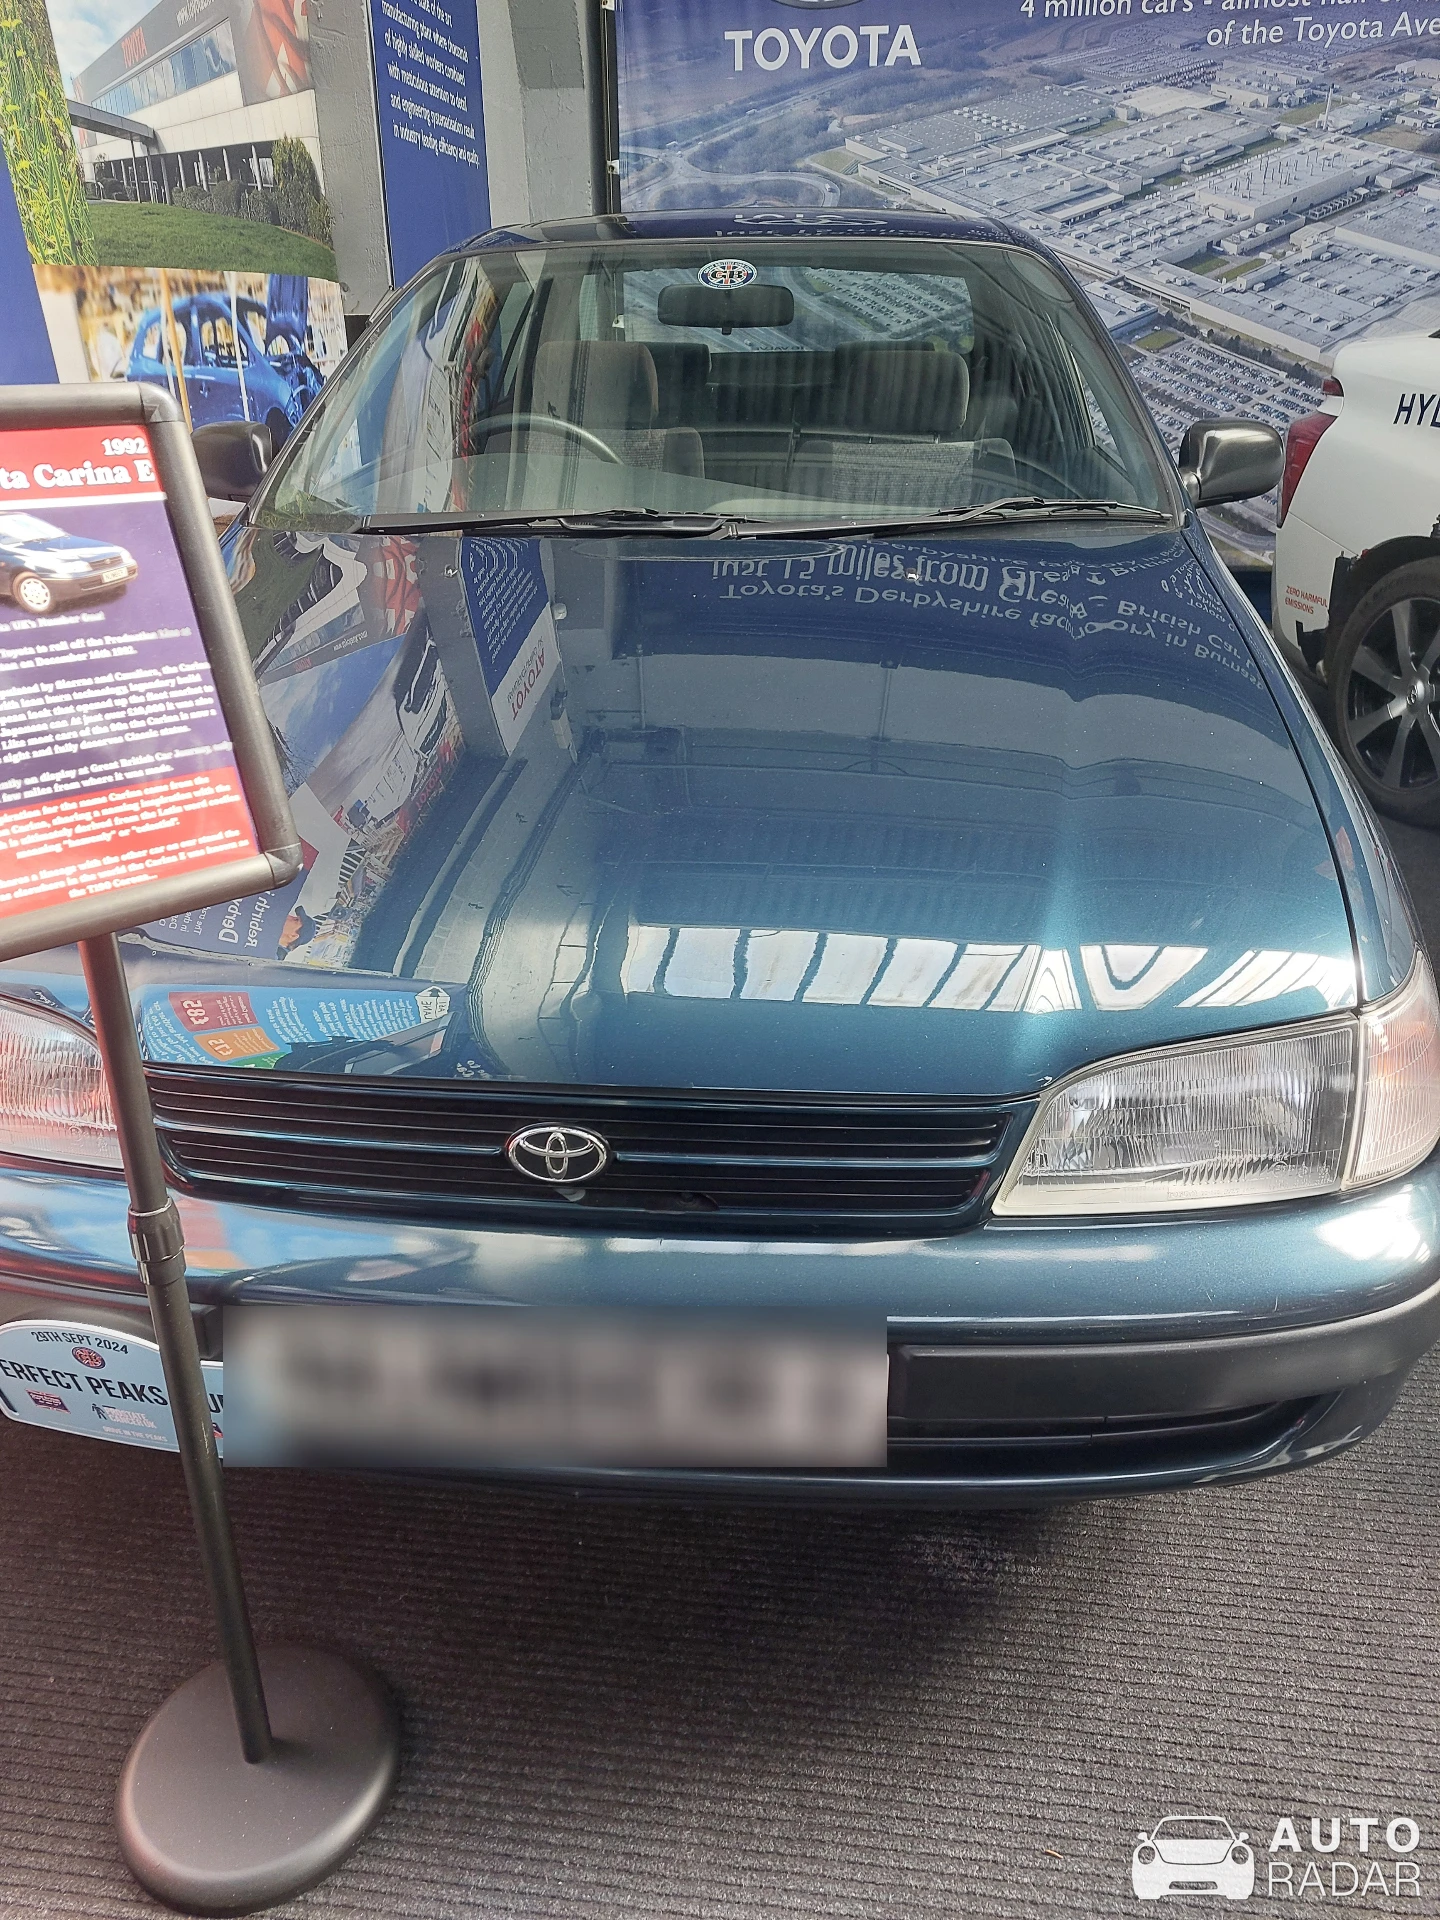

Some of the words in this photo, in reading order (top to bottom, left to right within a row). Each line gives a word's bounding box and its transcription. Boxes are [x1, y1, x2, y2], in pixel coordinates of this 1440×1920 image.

[1044, 0, 1130, 17] million
[1140, 0, 1193, 13] cars
[1206, 20, 1236, 46] of
[1240, 19, 1284, 45] the
[1293, 16, 1383, 49] Toyota
[121, 26, 147, 68] TOYOTA
[724, 24, 922, 72] TOYOTA
[101, 437, 148, 456] 1992
[33, 460, 132, 488] Carina
[133, 459, 155, 482] E
[1286, 585, 1300, 597] ZERO
[1300, 589, 1328, 608] HARMFUL
[1285, 597, 1314, 615] EMISSIONS
[36, 645, 47, 653] to
[86, 638, 103, 647] the
[34, 653, 88, 666] December
[93, 673, 114, 684] and
[32, 747, 53, 758] and
[90, 761, 118, 772] Great
[108, 790, 142, 801] Carina
[31, 1331, 63, 1343] 29TH
[64, 1334, 92, 1346] SEPT
[95, 1337, 129, 1355] 2024
[0, 1359, 83, 1392] ERFECT
[86, 1376, 168, 1406] PEAKS
